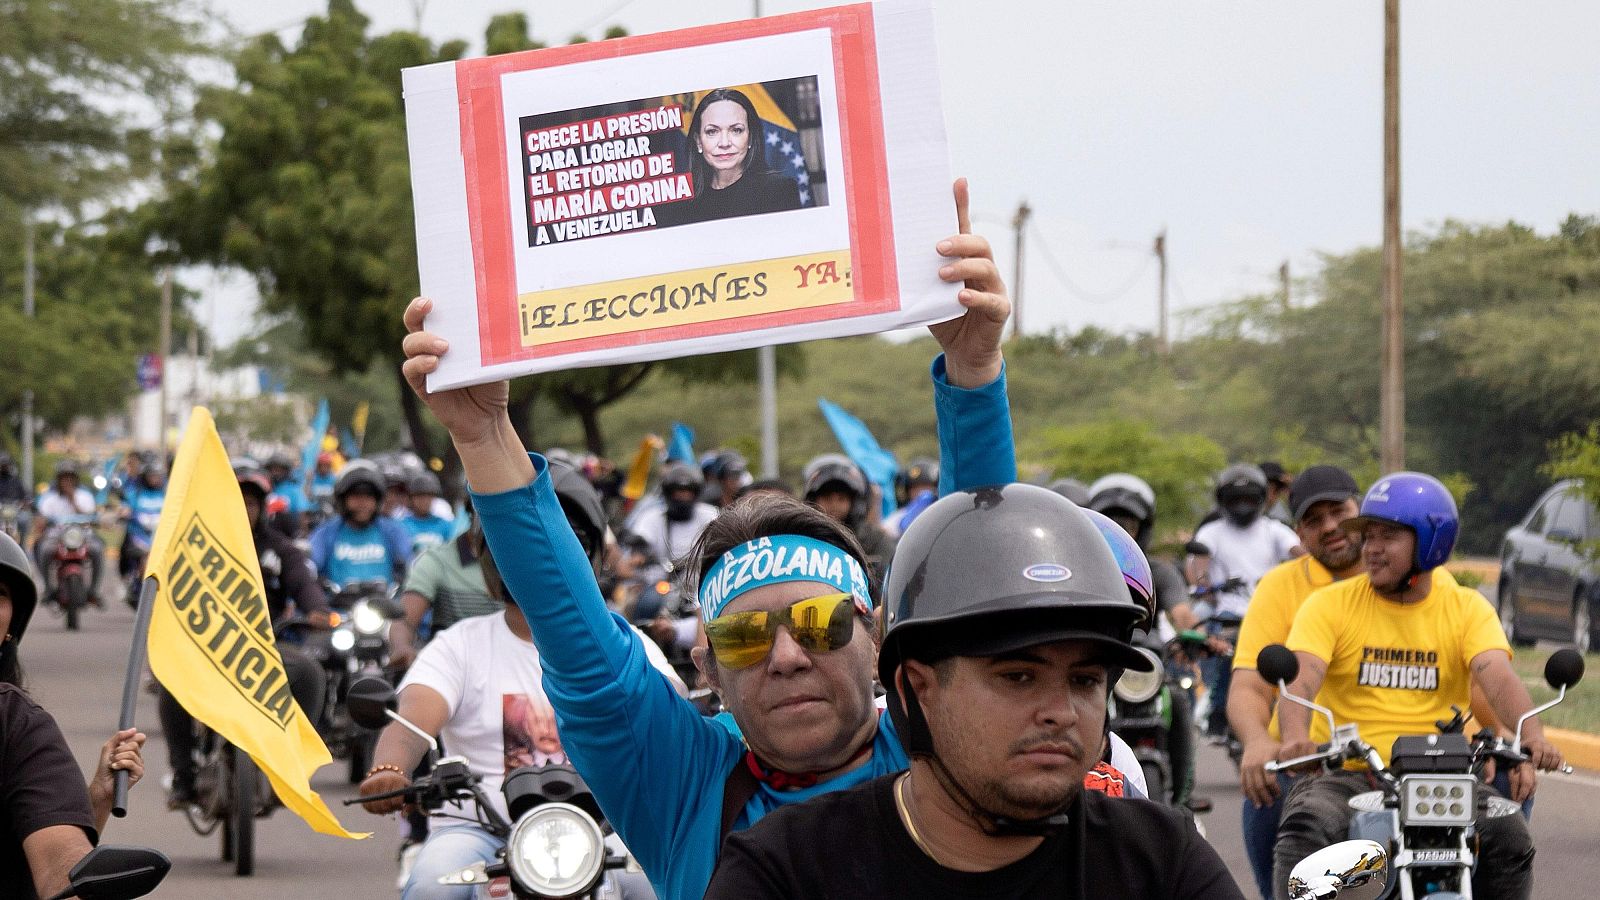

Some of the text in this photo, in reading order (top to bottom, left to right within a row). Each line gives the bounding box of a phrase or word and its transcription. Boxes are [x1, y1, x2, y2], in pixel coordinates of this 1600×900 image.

[527, 106, 682, 152] CRECE LA PRESIÓN
[529, 136, 651, 174] PARA LOGRAR
[531, 153, 674, 196] EL RETORNO DE
[534, 175, 692, 224] MARÍA CORINA
[536, 207, 657, 245] A VENEZUELA
[521, 272, 768, 337] ¡ELECCIONES
[747, 536, 772, 552] LA
[702, 546, 843, 624] VENEZOLANA
[1363, 646, 1438, 663] PRIMERO
[1360, 662, 1437, 690] JUSTICIA
